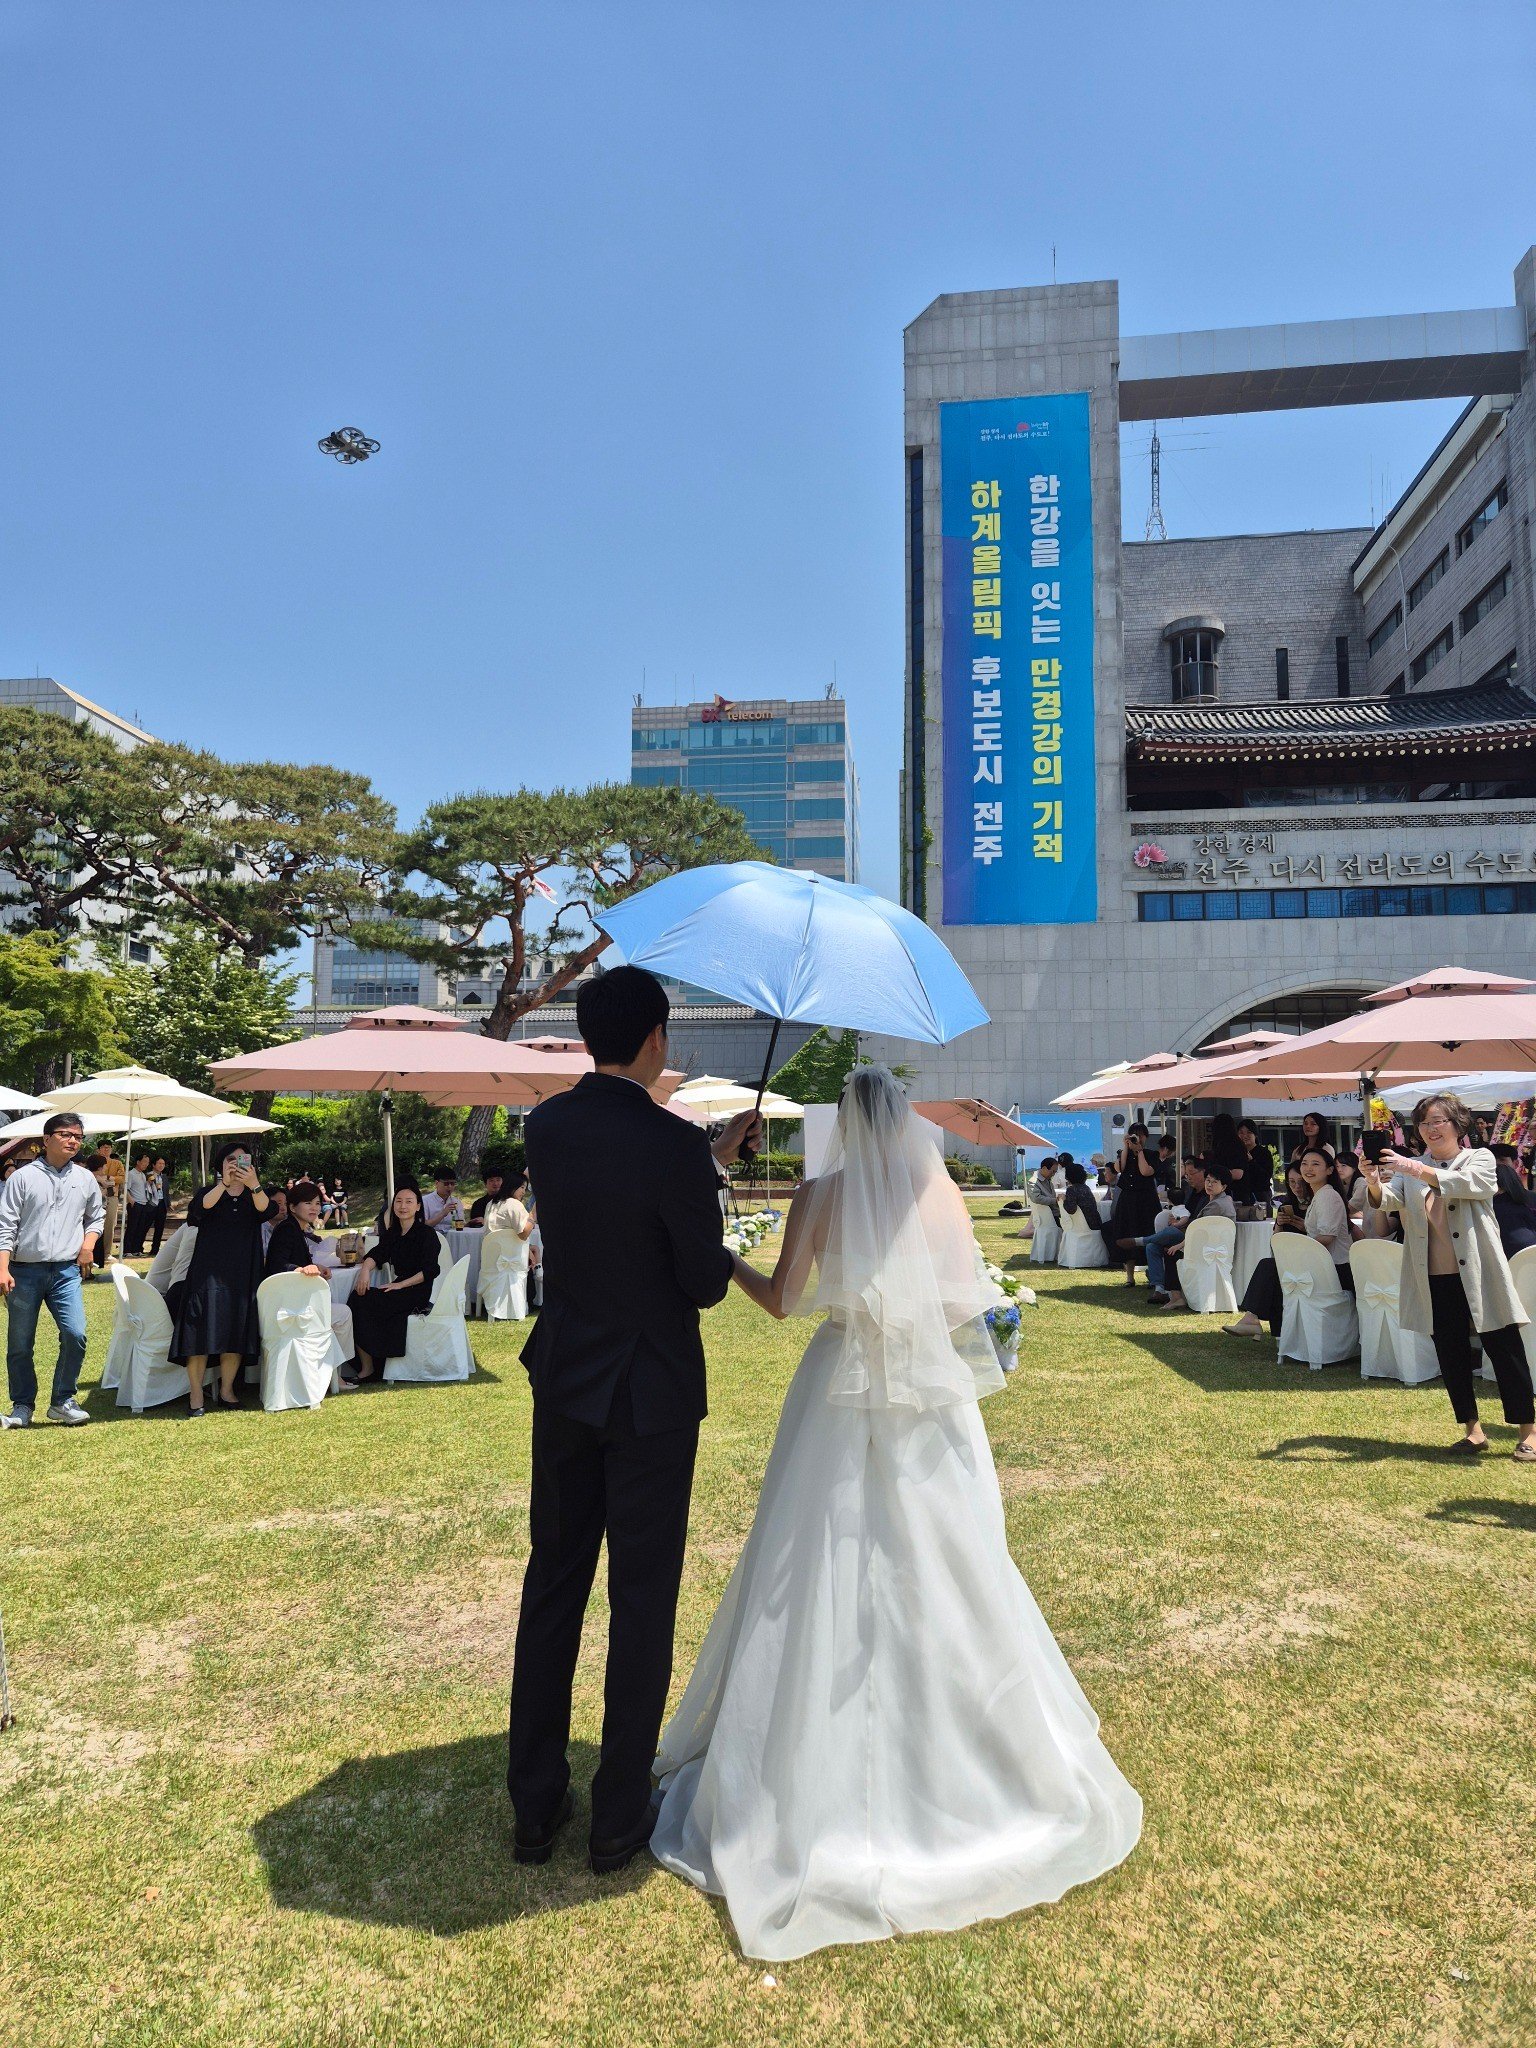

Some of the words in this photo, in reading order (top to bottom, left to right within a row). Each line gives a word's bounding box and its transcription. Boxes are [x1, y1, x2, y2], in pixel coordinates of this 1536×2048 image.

[1029, 474, 1061, 568] 한강을
[970, 480, 1002, 640] 하계올림픽
[1031, 582, 1061, 644] 잇는
[727, 710, 774, 722] telecom
[971, 655, 1003, 785] 후보도시
[1031, 658, 1063, 785] 만경강의
[972, 802, 1003, 865] 전주
[1032, 800, 1063, 863] 기적
[1193, 835, 1233, 855] 강한
[1239, 833, 1276, 854] 경제
[1193, 857, 1260, 885] 전주,
[1270, 854, 1326, 883] 다시
[1337, 850, 1455, 882] 전라도의
[1465, 850, 1536, 879] 수도
[1025, 1121, 1046, 1130] Happy
[1048, 1120, 1075, 1129] Wedding
[1076, 1120, 1091, 1130] Day
